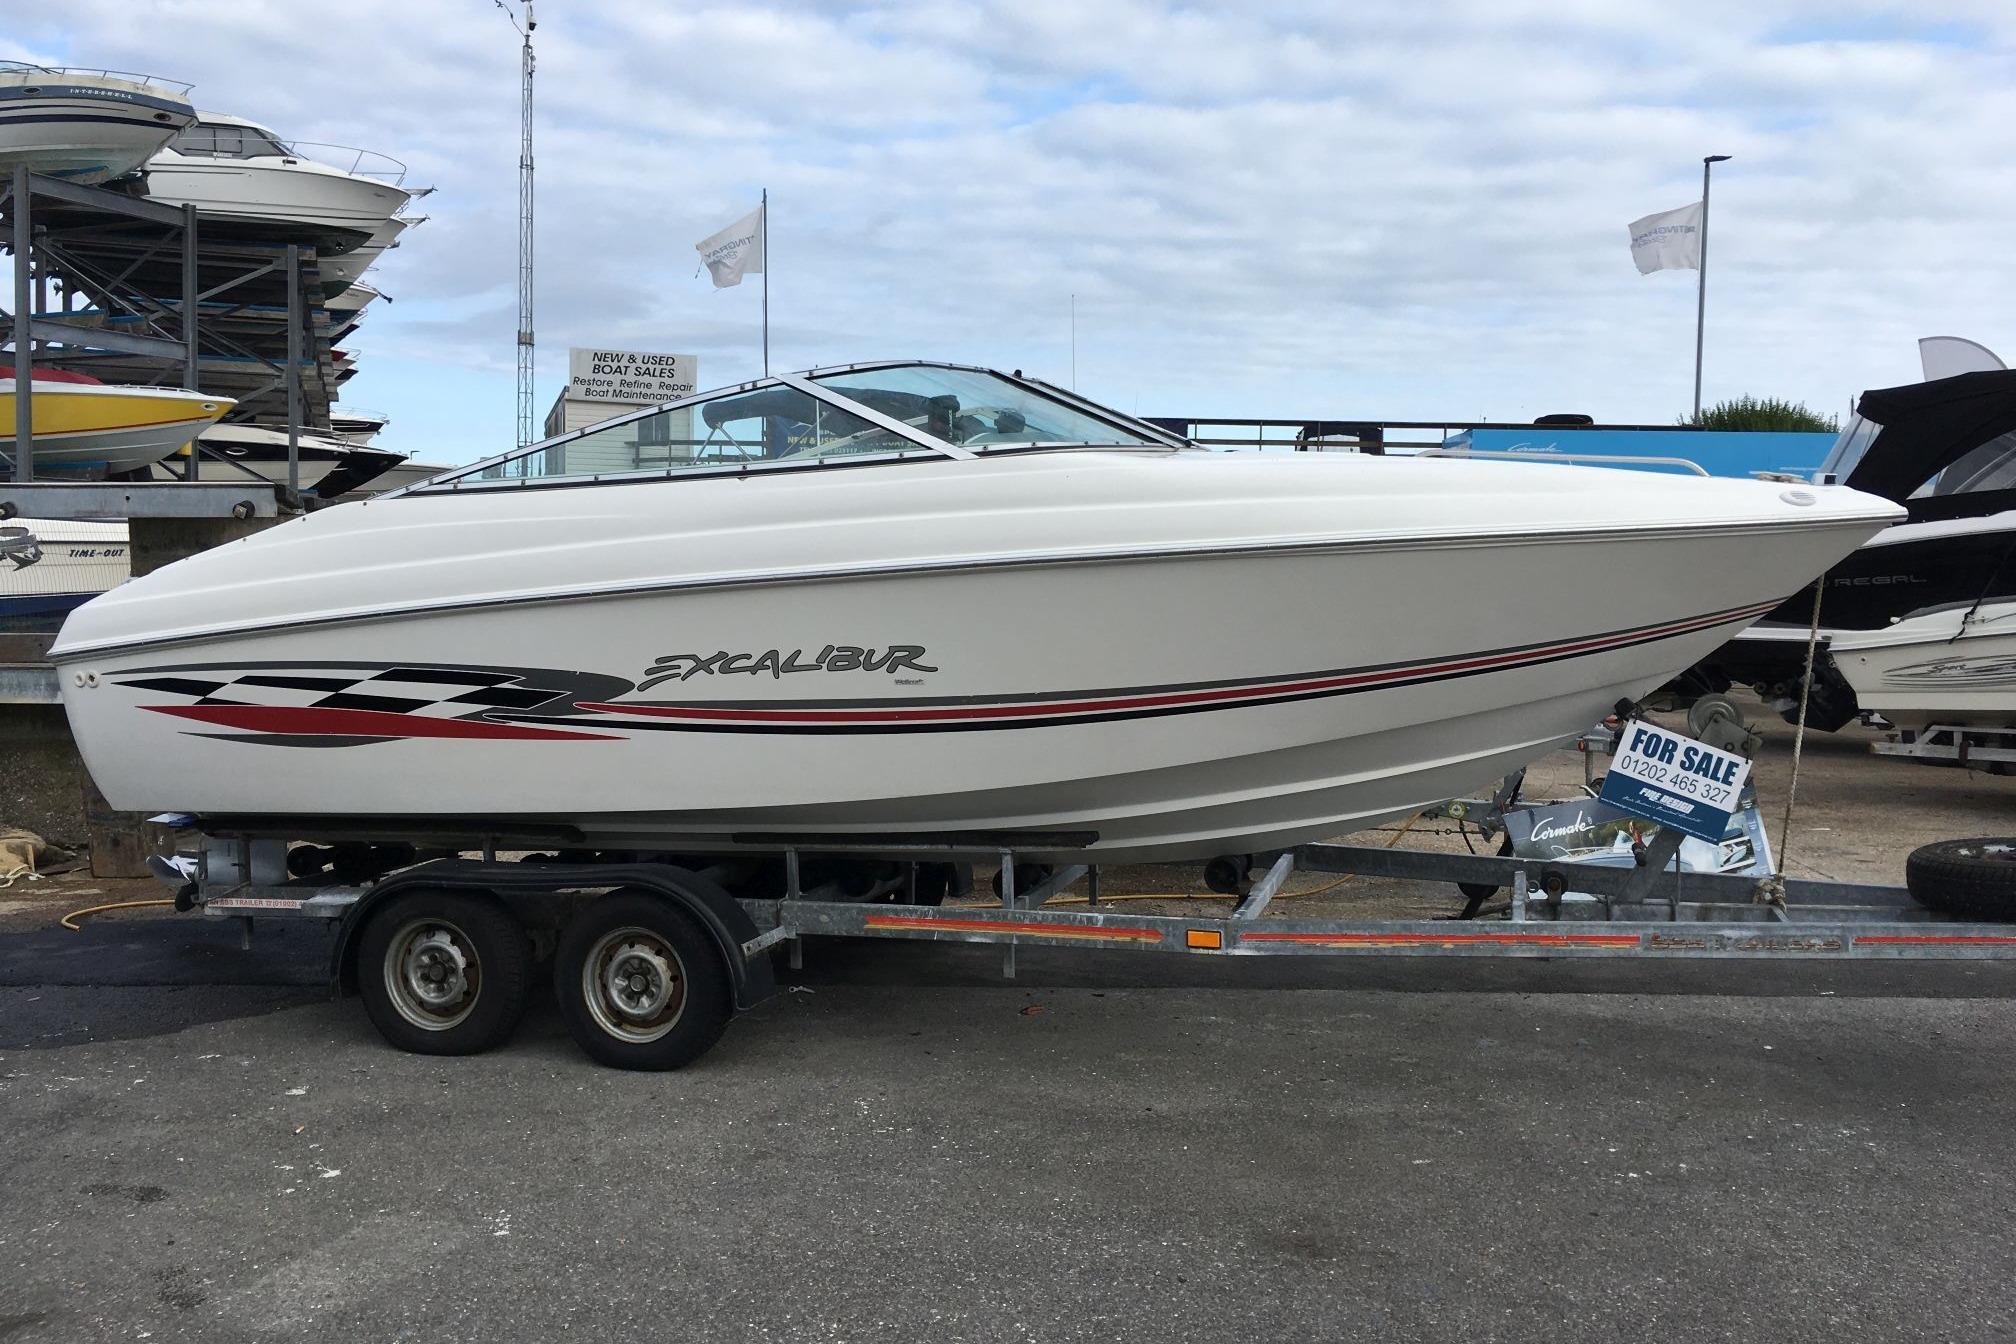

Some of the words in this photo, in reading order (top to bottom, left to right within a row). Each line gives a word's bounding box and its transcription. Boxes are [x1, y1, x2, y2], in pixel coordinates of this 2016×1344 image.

[592, 352, 625, 363] NEW
[627, 354, 637, 364] &
[642, 355, 675, 366] USED
[592, 364, 630, 376] BOAT
[633, 366, 675, 379] SALES
[573, 376, 614, 388] Restore
[620, 379, 653, 390] Refine
[658, 381, 694, 392] Repair
[584, 388, 609, 398] Boat
[612, 389, 682, 401] Maintenance
[69, 549, 125, 558] TIME-OUT
[1834, 575, 1925, 587] REGAL
[637, 645, 938, 692] EXCALIBUR
[1629, 727, 1679, 765] FOR
[1679, 746, 1740, 787] SALE
[1621, 755, 1668, 783] 01202
[1669, 771, 1699, 794] 465
[1700, 783, 1731, 805] 327
[1530, 810, 1595, 842] Cormate
